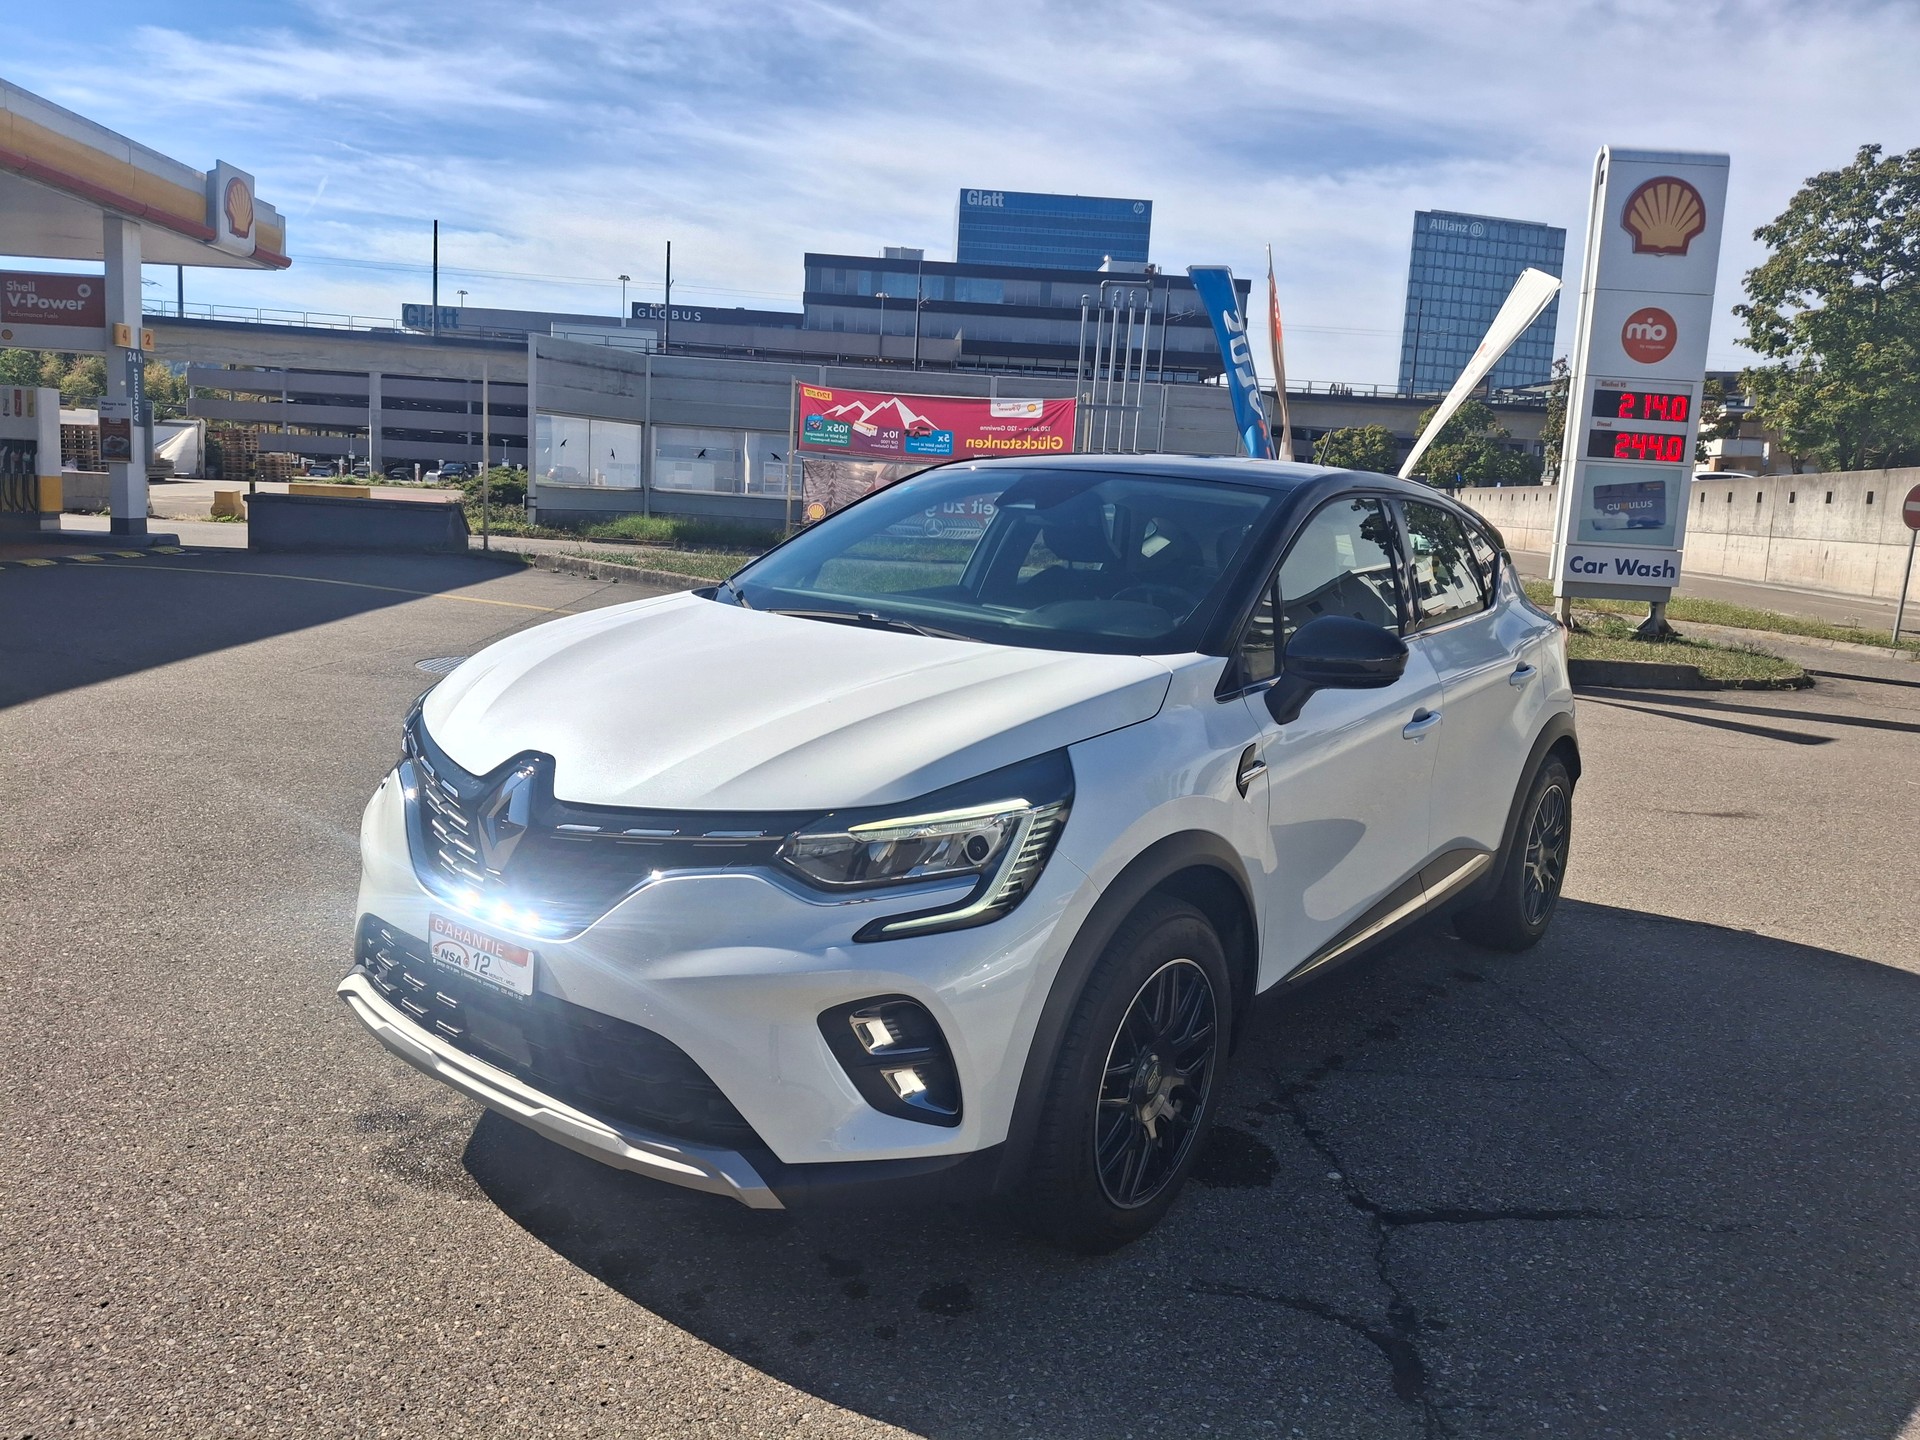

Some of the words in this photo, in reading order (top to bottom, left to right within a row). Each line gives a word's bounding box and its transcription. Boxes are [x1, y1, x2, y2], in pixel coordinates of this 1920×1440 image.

[966, 190, 1004, 207] Glatt
[1430, 219, 1468, 233] Allianz
[6, 281, 35, 292] Shell
[7, 292, 86, 311] V-Power
[403, 304, 460, 329] Glatt
[637, 308, 702, 321] GLOBUS
[122, 329, 128, 342] 4
[1626, 317, 1667, 341] mio
[145, 334, 151, 345] 2
[127, 352, 137, 362] 24
[138, 354, 143, 363] h
[1614, 433, 1684, 462] 244.0
[1570, 556, 1607, 575] Car
[1615, 558, 1676, 579] Wash
[434, 918, 504, 957] GARANTIE
[440, 948, 461, 966] NSA
[473, 952, 491, 976] 12
